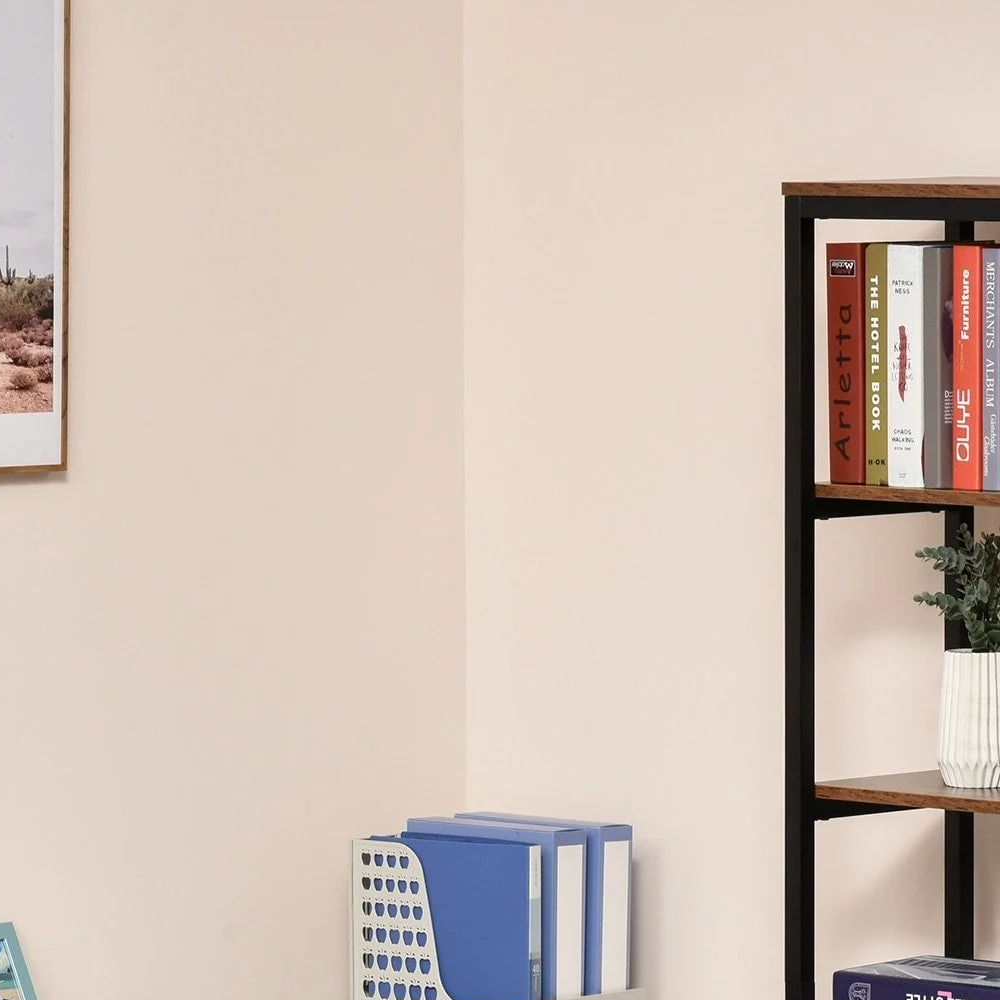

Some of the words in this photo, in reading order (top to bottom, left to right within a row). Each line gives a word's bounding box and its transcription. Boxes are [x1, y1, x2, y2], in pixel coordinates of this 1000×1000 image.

[870, 274, 879, 310] THE
[961, 269, 970, 340] Furniture
[985, 261, 995, 349] MERCHANTS
[870, 317, 880, 374] HOTEL
[833, 303, 852, 461] Arletta
[871, 382, 881, 431] BOOK
[985, 359, 995, 408] ALBUM
